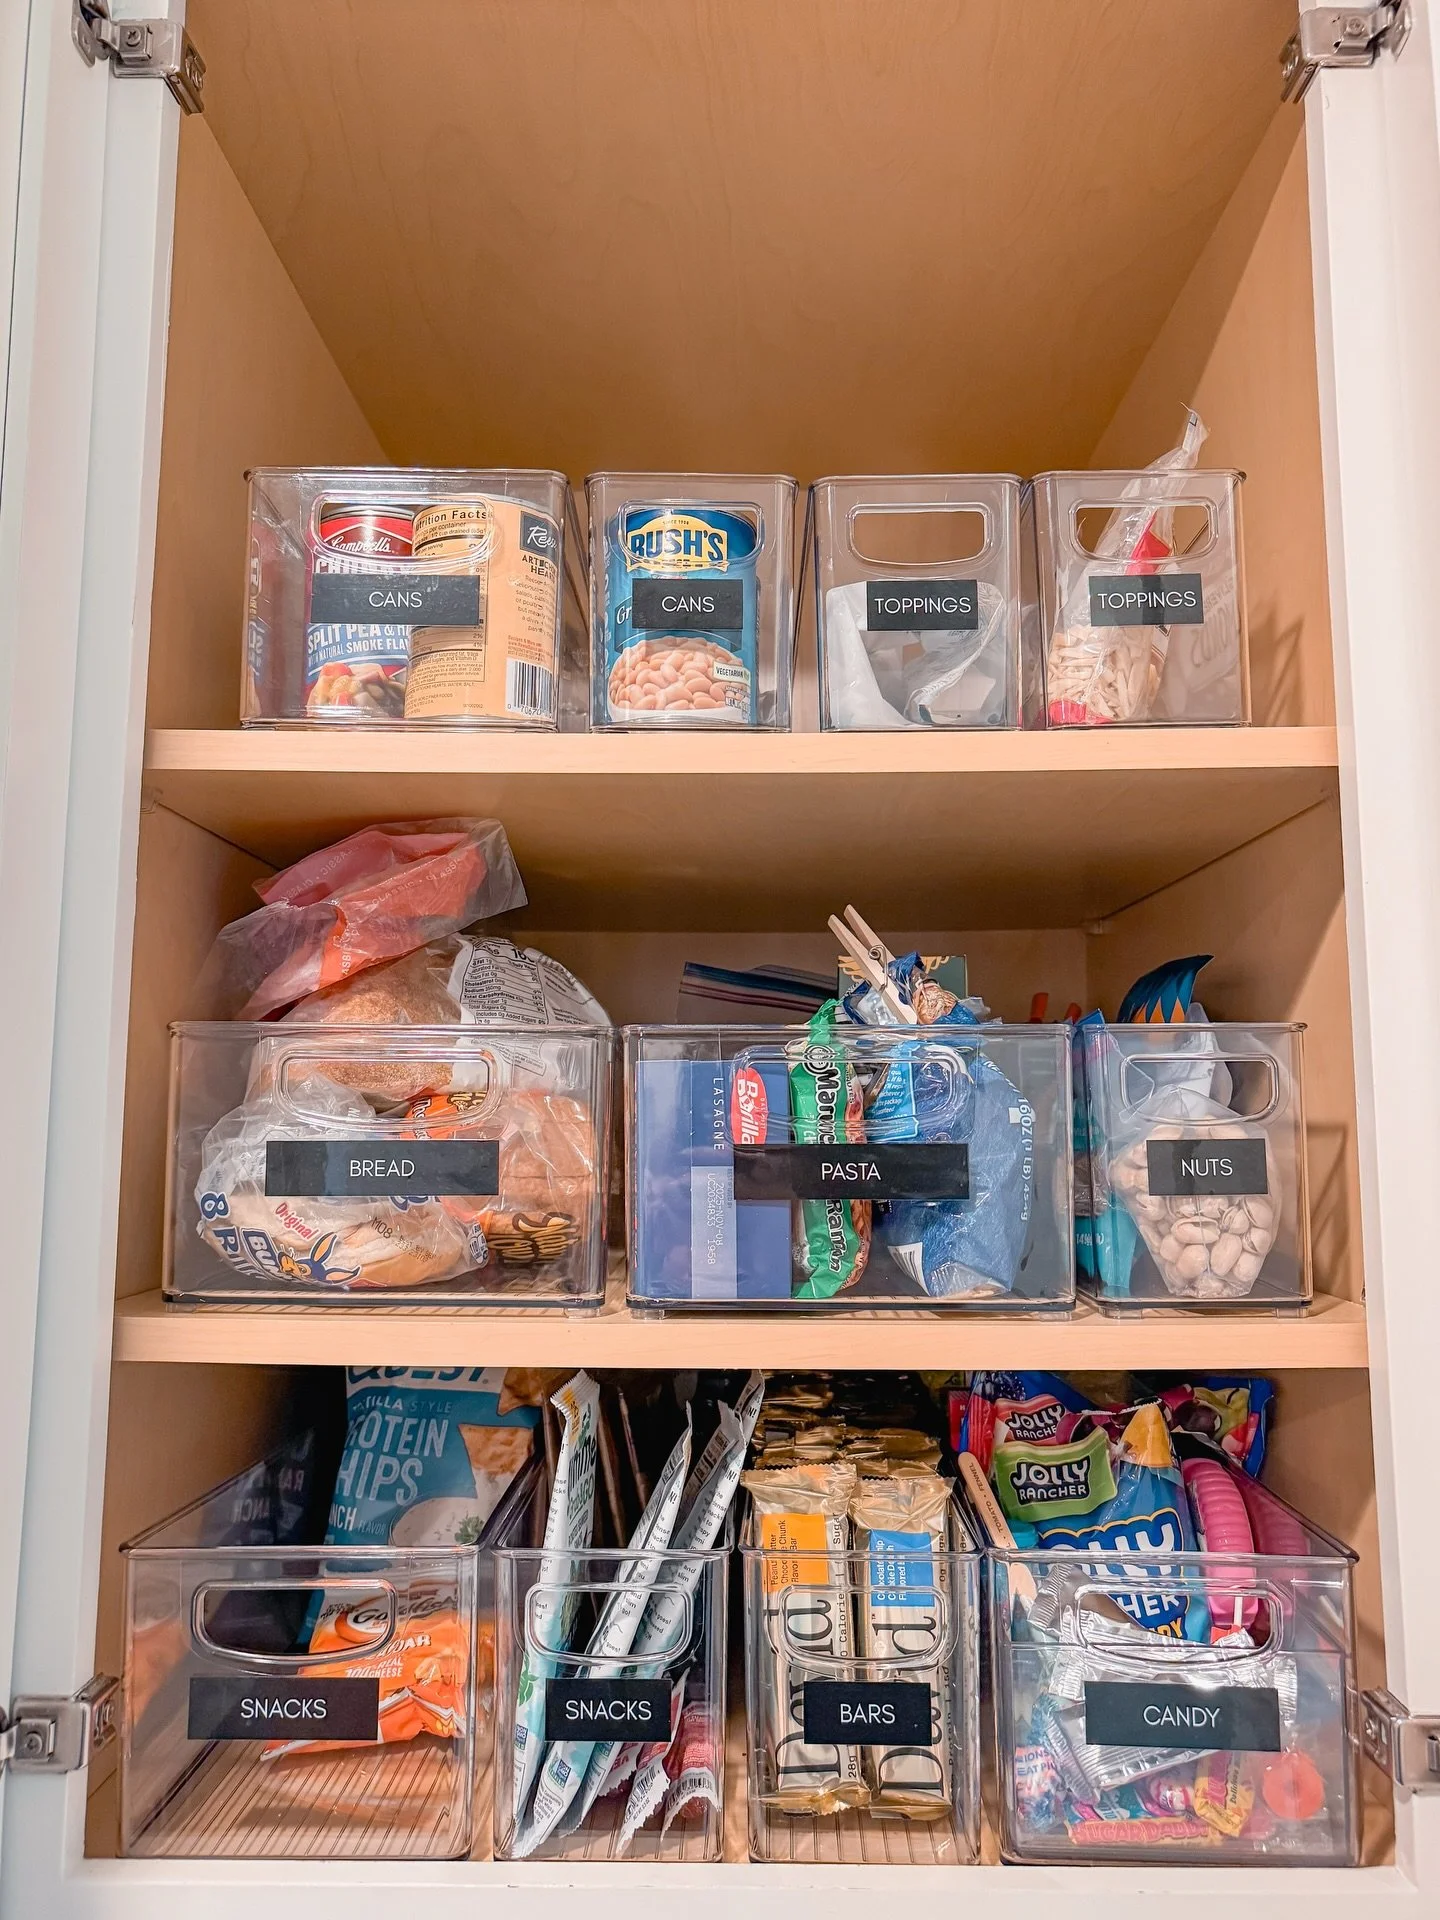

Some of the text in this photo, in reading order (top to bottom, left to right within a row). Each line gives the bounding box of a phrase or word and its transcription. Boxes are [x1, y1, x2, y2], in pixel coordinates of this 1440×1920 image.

[416, 510, 487, 531] utrition Facts
[331, 536, 392, 554] Campbell's
[630, 528, 724, 563] BUSH'S
[369, 591, 423, 608] CANS
[661, 596, 715, 613] CANS
[874, 596, 972, 614] TOPPINGS
[1097, 590, 1197, 609] TOPPINGS
[308, 624, 341, 654] SPLIT
[345, 624, 382, 640] PEA
[346, 640, 384, 655] SMOKE
[386, 638, 409, 651] FLAV
[426, 855, 462, 881] CLASSI
[713, 1077, 724, 1150] LASAGNE
[738, 1077, 759, 1144] Barilla
[816, 1065, 840, 1144] Maruc
[350, 1159, 415, 1177] BREAD
[821, 1163, 881, 1181] PASTA
[1021, 1157, 1034, 1181] LB)
[1181, 1159, 1234, 1177] NUTS
[200, 1191, 231, 1220] 8
[715, 1182, 725, 1247] 2025-NOV-08
[275, 1201, 320, 1240] Original
[706, 1172, 716, 1265] UC2034833 1958
[352, 1395, 453, 1414] TILLA STYLE
[1008, 1404, 1064, 1429] JOLLY
[344, 1411, 449, 1459] ROTEIN
[1015, 1425, 1057, 1440] RANCHE
[335, 1449, 424, 1507] HIPS
[1013, 1459, 1090, 1488] JOLLY
[969, 1462, 1004, 1537] TOMATO FENNEL
[1019, 1484, 1088, 1501] RANCHER
[358, 1521, 387, 1536] FLAVOR
[832, 1512, 842, 1546] Sugar
[778, 1519, 789, 1584] Chocoe Chunk
[876, 1553, 886, 1601] Ccolate
[888, 1572, 897, 1601] Ckie
[897, 1566, 907, 1601] Flored
[836, 1593, 848, 1643] Calorie
[369, 1666, 403, 1678] CHEESE
[240, 1698, 327, 1720] SNACKS
[565, 1699, 652, 1720] SNACKS
[840, 1703, 896, 1724] BARS
[1143, 1704, 1221, 1728] CANDY
[847, 1755, 858, 1779] 28g
